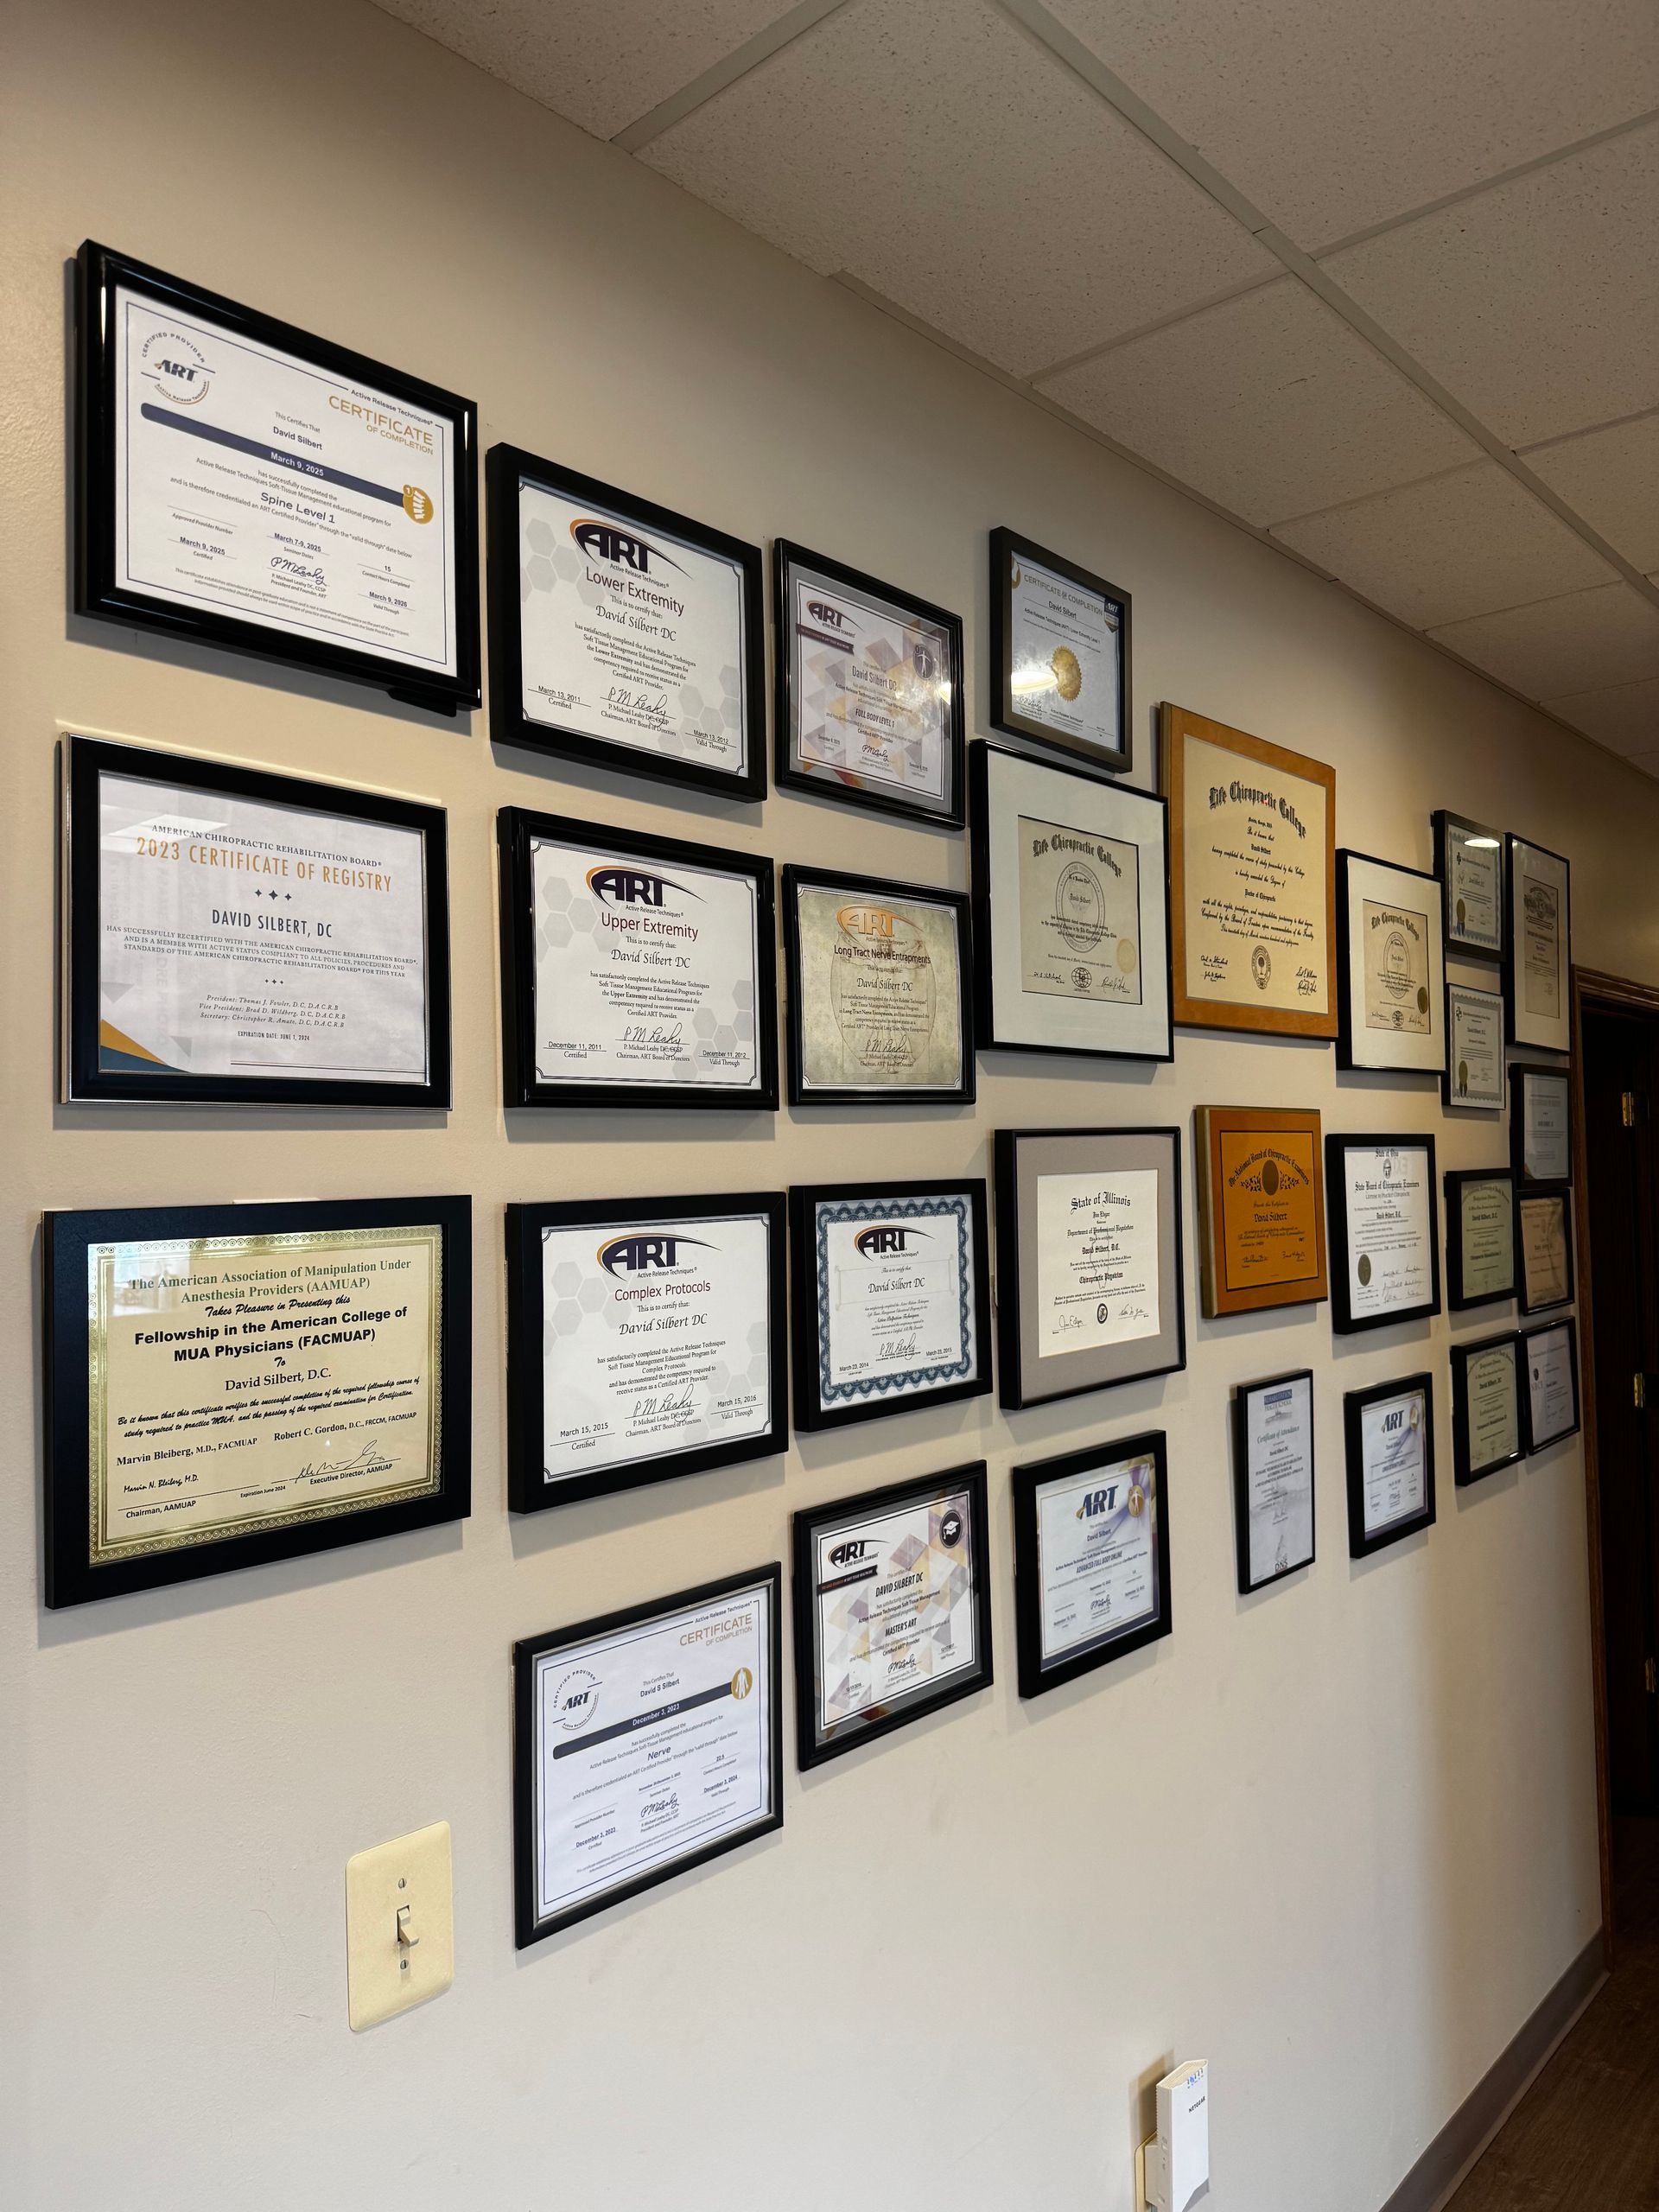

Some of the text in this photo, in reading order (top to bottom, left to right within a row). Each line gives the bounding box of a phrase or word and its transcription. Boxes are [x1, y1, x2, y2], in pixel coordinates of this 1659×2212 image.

[329, 396, 433, 446] CERTIFICATE
[274, 426, 322, 450] David Silbert
[380, 430, 433, 455] COMPLETION
[271, 452, 323, 476] March 9, 2025
[261, 493, 334, 524] Spine Level 1
[587, 567, 684, 616] Lower Extremity
[1024, 575, 1061, 596] CERTIFICATE
[1049, 601, 1062, 613] David
[1068, 594, 1103, 615] COMPLETION
[596, 606, 676, 641] David Silbert DC
[852, 665, 868, 681] David
[855, 709, 866, 718] FULL
[868, 713, 878, 723] BODY
[879, 716, 891, 727] LEVEL
[1210, 781, 1306, 839] Life Chiropractic College
[152, 825, 202, 838] AMERICAN
[205, 833, 273, 850] CHIROPRACTIC
[276, 845, 347, 861] REHABILITATION
[137, 837, 391, 892] 2023 CERTIFICATE OF REGISTRY
[1033, 834, 1122, 878] Life Chiropractic College
[213, 910, 332, 938] DAVID SILBERT, DC
[602, 912, 698, 940] Upper Extremity
[1382, 912, 1404, 927] Chiropractic
[611, 950, 690, 968] David Silbert DC
[835, 945, 931, 963] Long Tract Nerve Entrapments
[857, 978, 913, 991] David Silbert DC
[1071, 1192, 1130, 1214] State of Illinois
[1254, 1213, 1268, 1222] David
[1083, 1245, 1094, 1255] David
[131, 1260, 411, 1289] The American Association of Manipulation Under
[868, 1278, 925, 1293] David Silbert DC
[1079, 1274, 1103, 1284] Chiropractic
[181, 1277, 370, 1303] Anesthesia Providers (AAMUAP)
[615, 1281, 710, 1301] Complex Protocols
[136, 1306, 407, 1344] Fellowship in the American College of
[620, 1313, 708, 1335] David Silbert DC
[175, 1329, 375, 1362] MUA Physicians (FACMUAP)
[275, 1357, 285, 1367] To
[226, 1368, 331, 1390] David Silbert, D.C.
[561, 1428, 579, 1437] March
[594, 1422, 608, 1431] 2015
[1382, 1410, 1404, 1433] ART
[1257, 1433, 1275, 1444] Certificate
[126, 1500, 196, 1518] Chairman, AAMUAP
[1077, 1485, 1119, 1520] ART
[1087, 1533, 1098, 1541] David
[830, 1540, 866, 1565] ART
[876, 1572, 923, 1597] DAVID SILBERT DC
[680, 1613, 752, 1646] CERTIFICATE
[715, 1626, 753, 1643] COMPLETION
[885, 1618, 917, 1637] MASTER'S ART
[640, 1687, 656, 1697] David
[663, 1679, 679, 1689] Silbert
[562, 1690, 591, 1711] ART
[632, 1712, 660, 1726] December
[667, 1703, 679, 1713] 2023
[648, 1747, 671, 1761] Nerve
